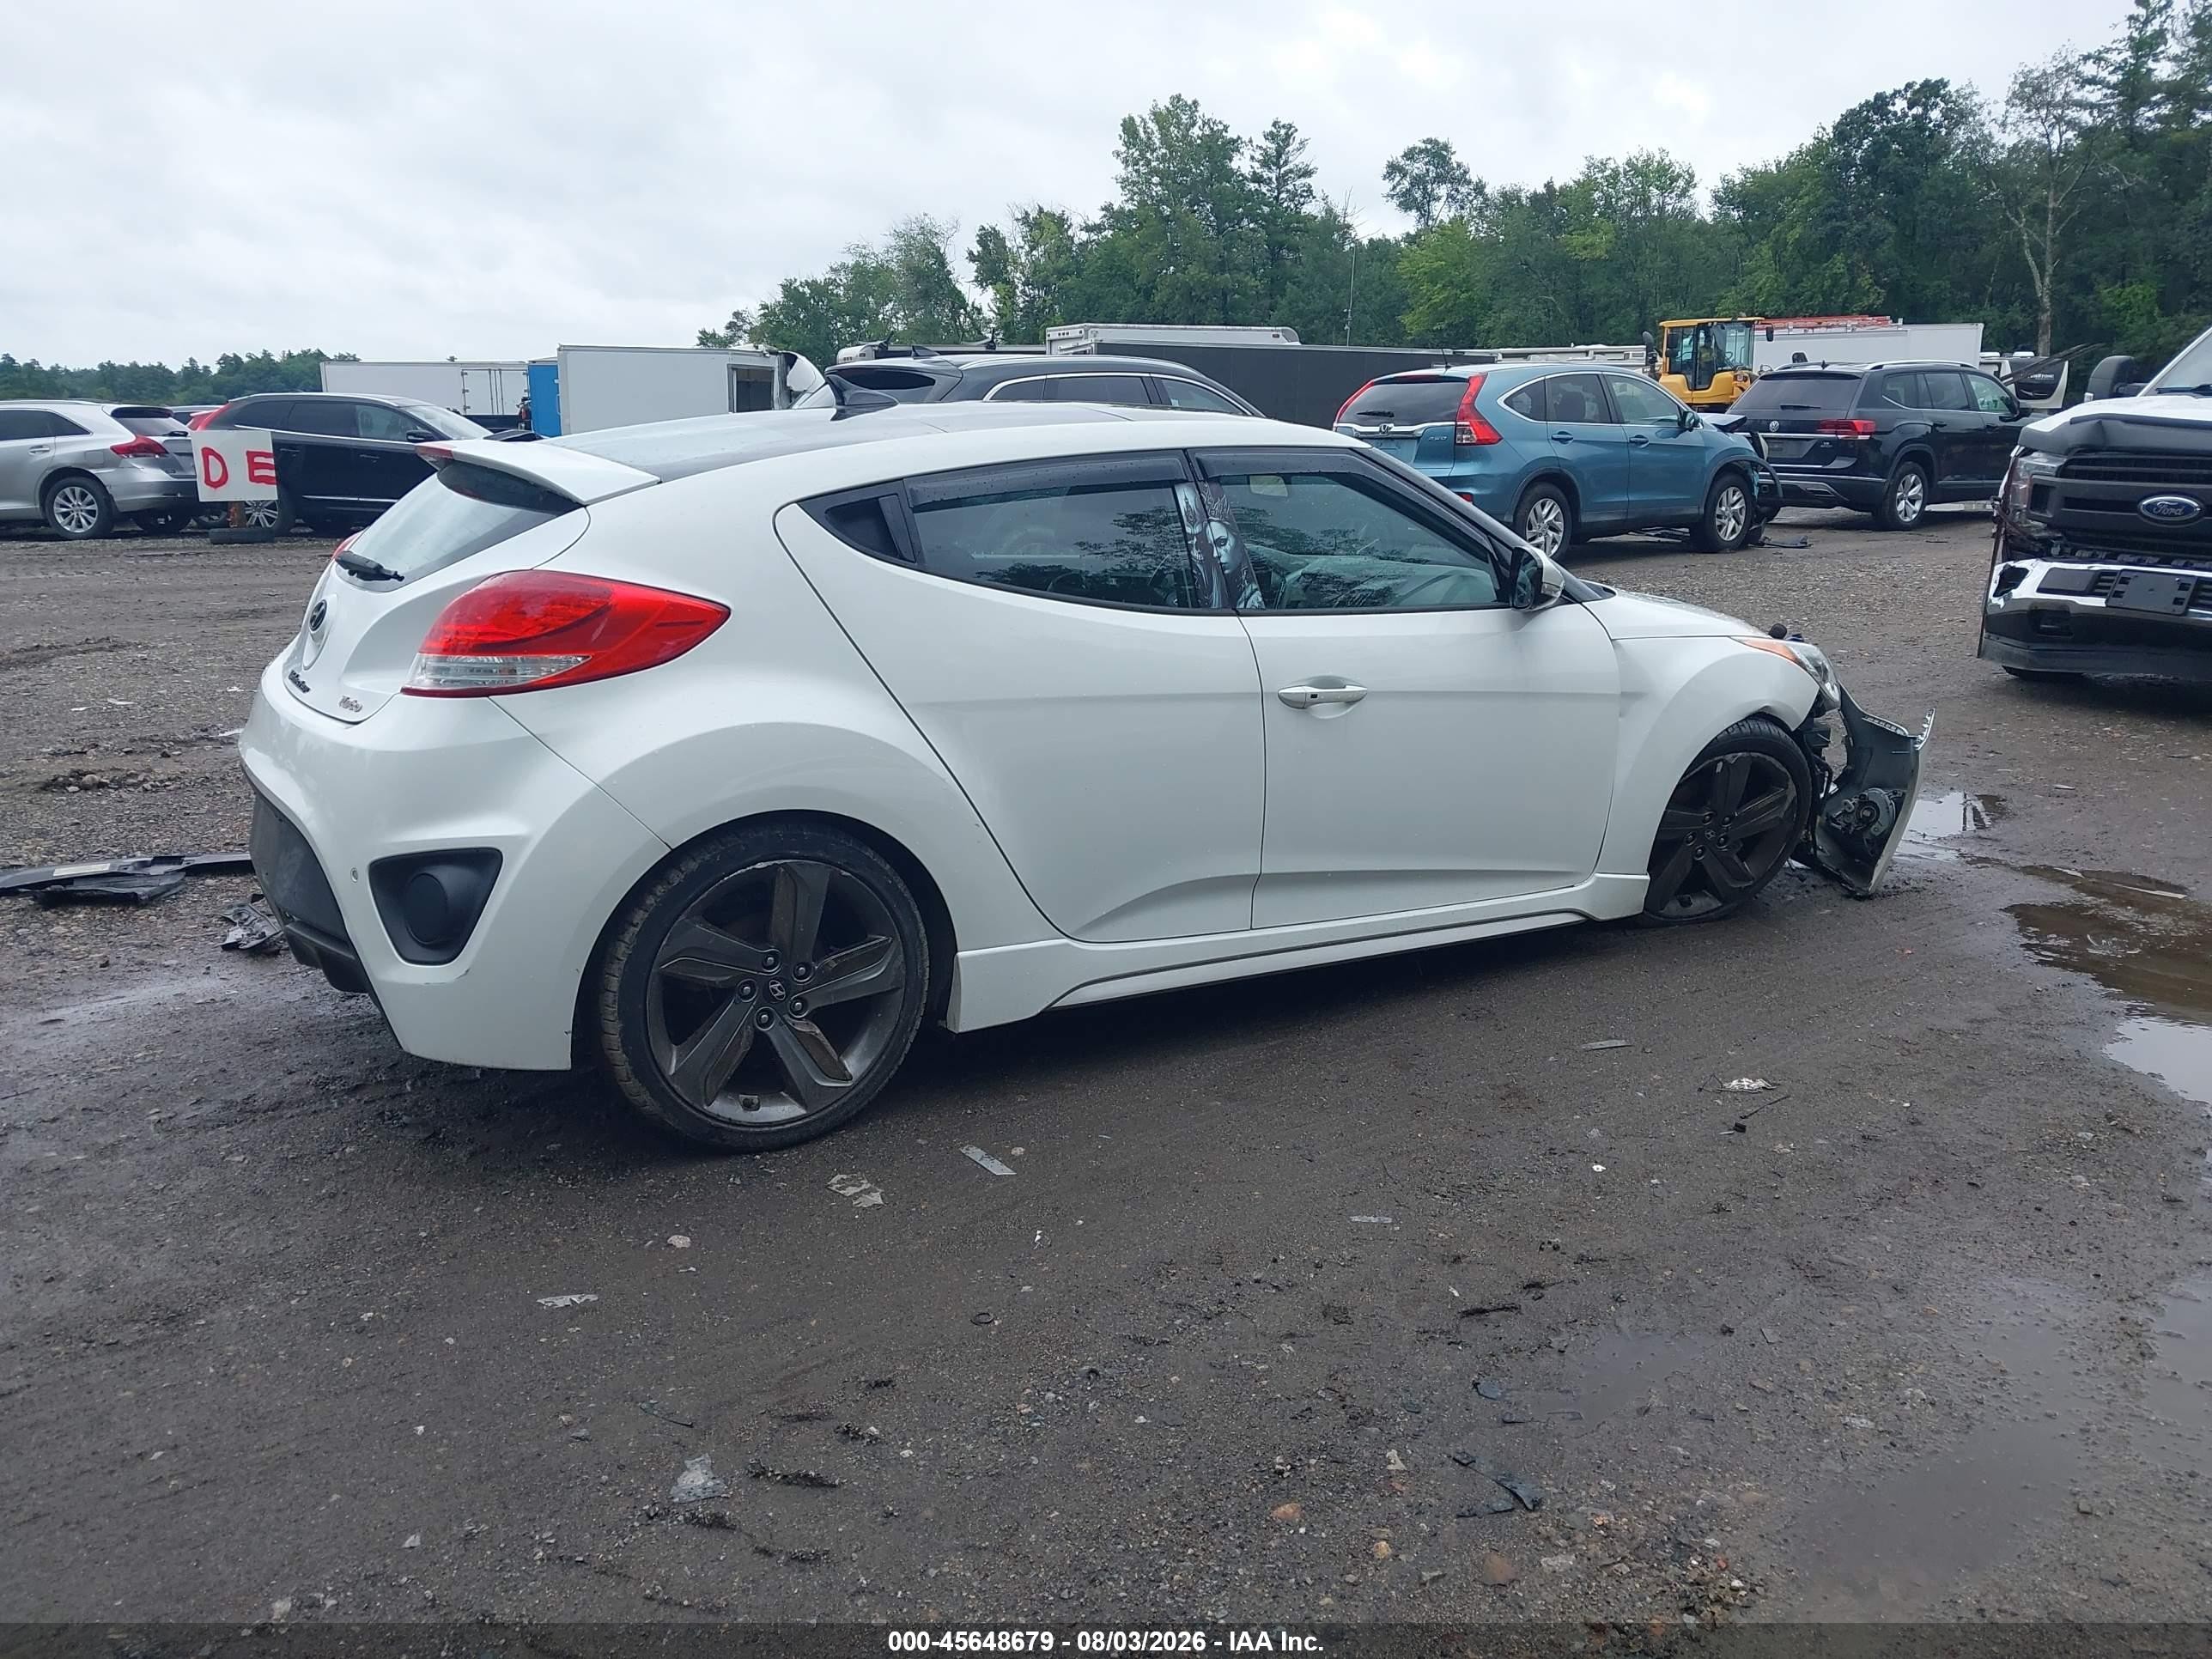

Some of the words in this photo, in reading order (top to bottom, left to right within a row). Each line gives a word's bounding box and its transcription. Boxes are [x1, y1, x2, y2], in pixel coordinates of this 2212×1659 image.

[200, 447, 228, 489] D
[246, 450, 277, 485] E
[2153, 501, 2185, 516] Ford
